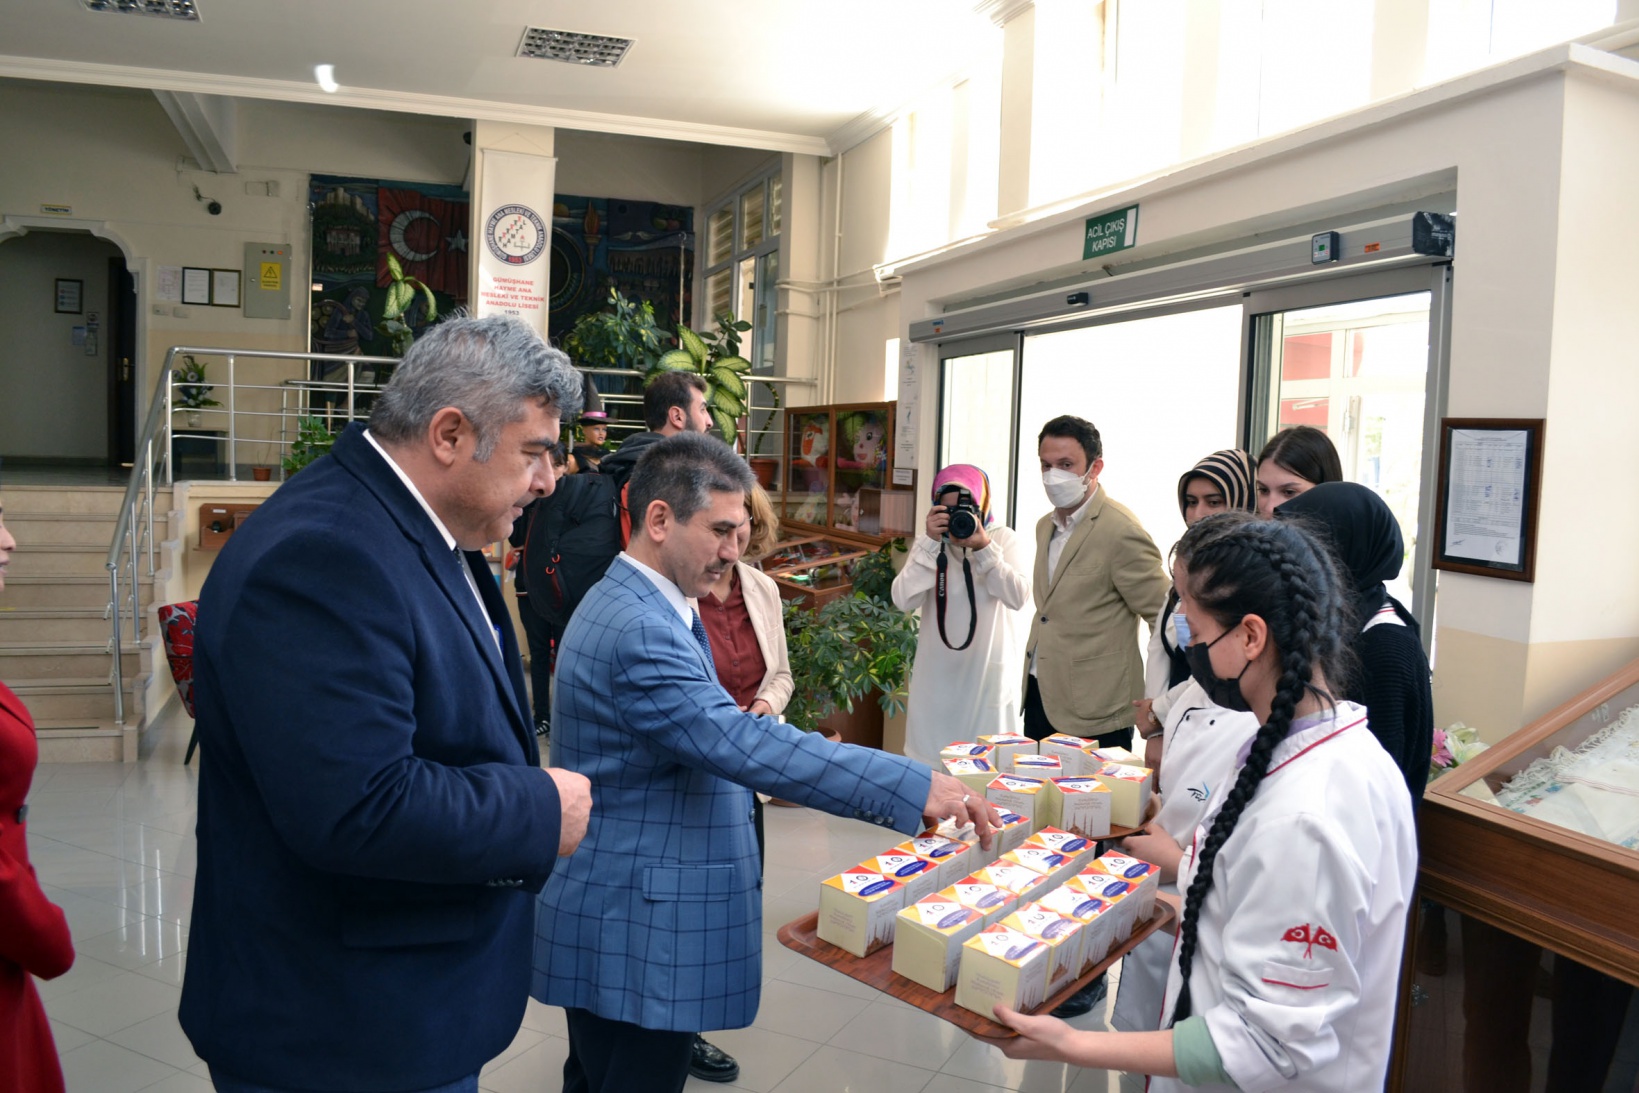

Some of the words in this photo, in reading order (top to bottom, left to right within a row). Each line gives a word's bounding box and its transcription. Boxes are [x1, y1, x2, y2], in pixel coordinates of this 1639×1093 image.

[1087, 224, 1104, 239] ACİL
[1104, 218, 1125, 236] ÇIKIŞ
[1092, 236, 1117, 252] KAPISI
[493, 277, 534, 286] GÜMÜŞHANE
[486, 300, 517, 308] ANADOLU
